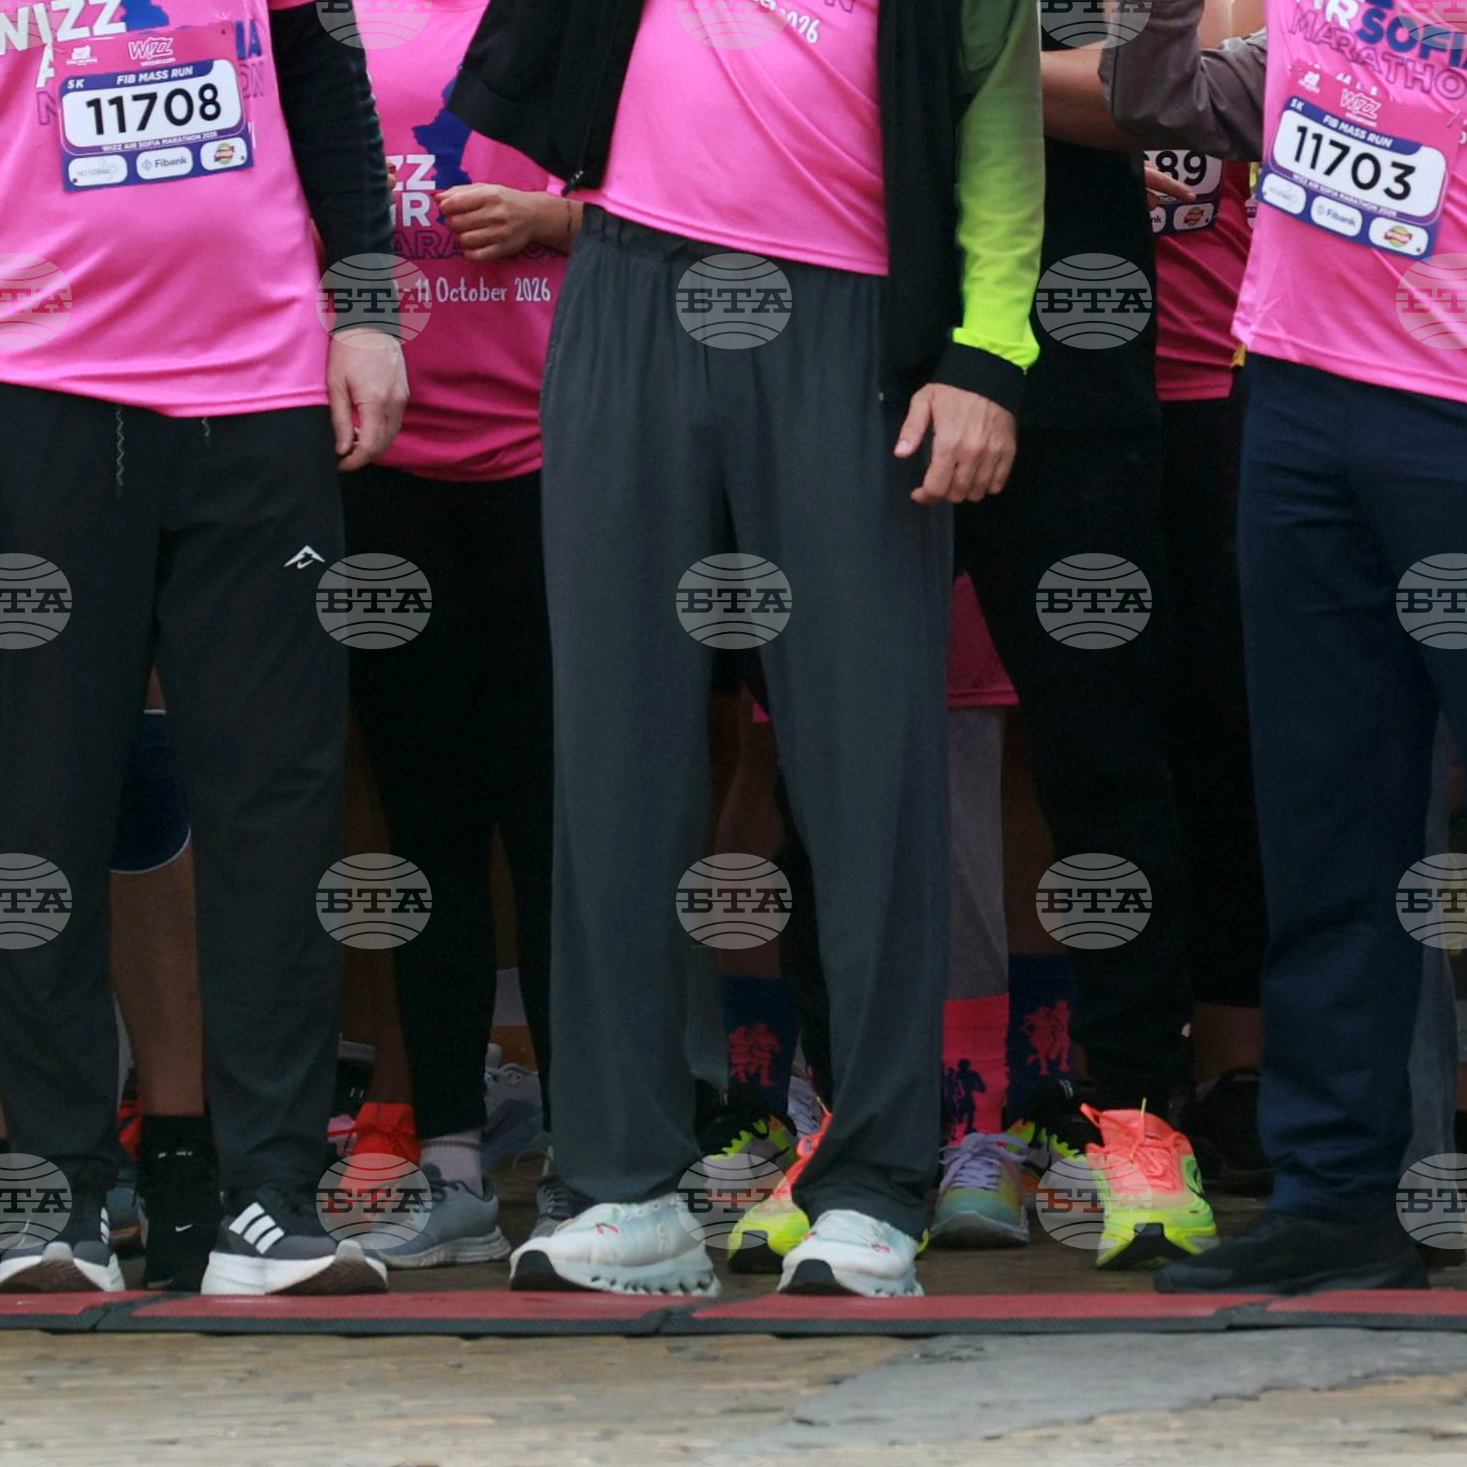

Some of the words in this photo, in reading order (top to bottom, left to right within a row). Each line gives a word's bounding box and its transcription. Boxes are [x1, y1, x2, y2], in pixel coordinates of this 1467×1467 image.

[116, 72, 136, 84] FIB
[138, 69, 169, 83] MASS
[171, 66, 194, 78] RUN
[86, 83, 221, 136] 11708
[139, 139, 161, 149] SOFIA
[162, 133, 202, 146] MARATHON
[1322, 114, 1340, 129] FIB
[1338, 121, 1368, 141] MASS
[1367, 130, 1393, 148] RUN
[154, 156, 188, 169] Fibank
[1143, 150, 1207, 187] 89
[1294, 124, 1417, 202] 11703
[1325, 207, 1357, 228] Fibank
[436, 276, 508, 304] October
[514, 277, 551, 302] 2026
